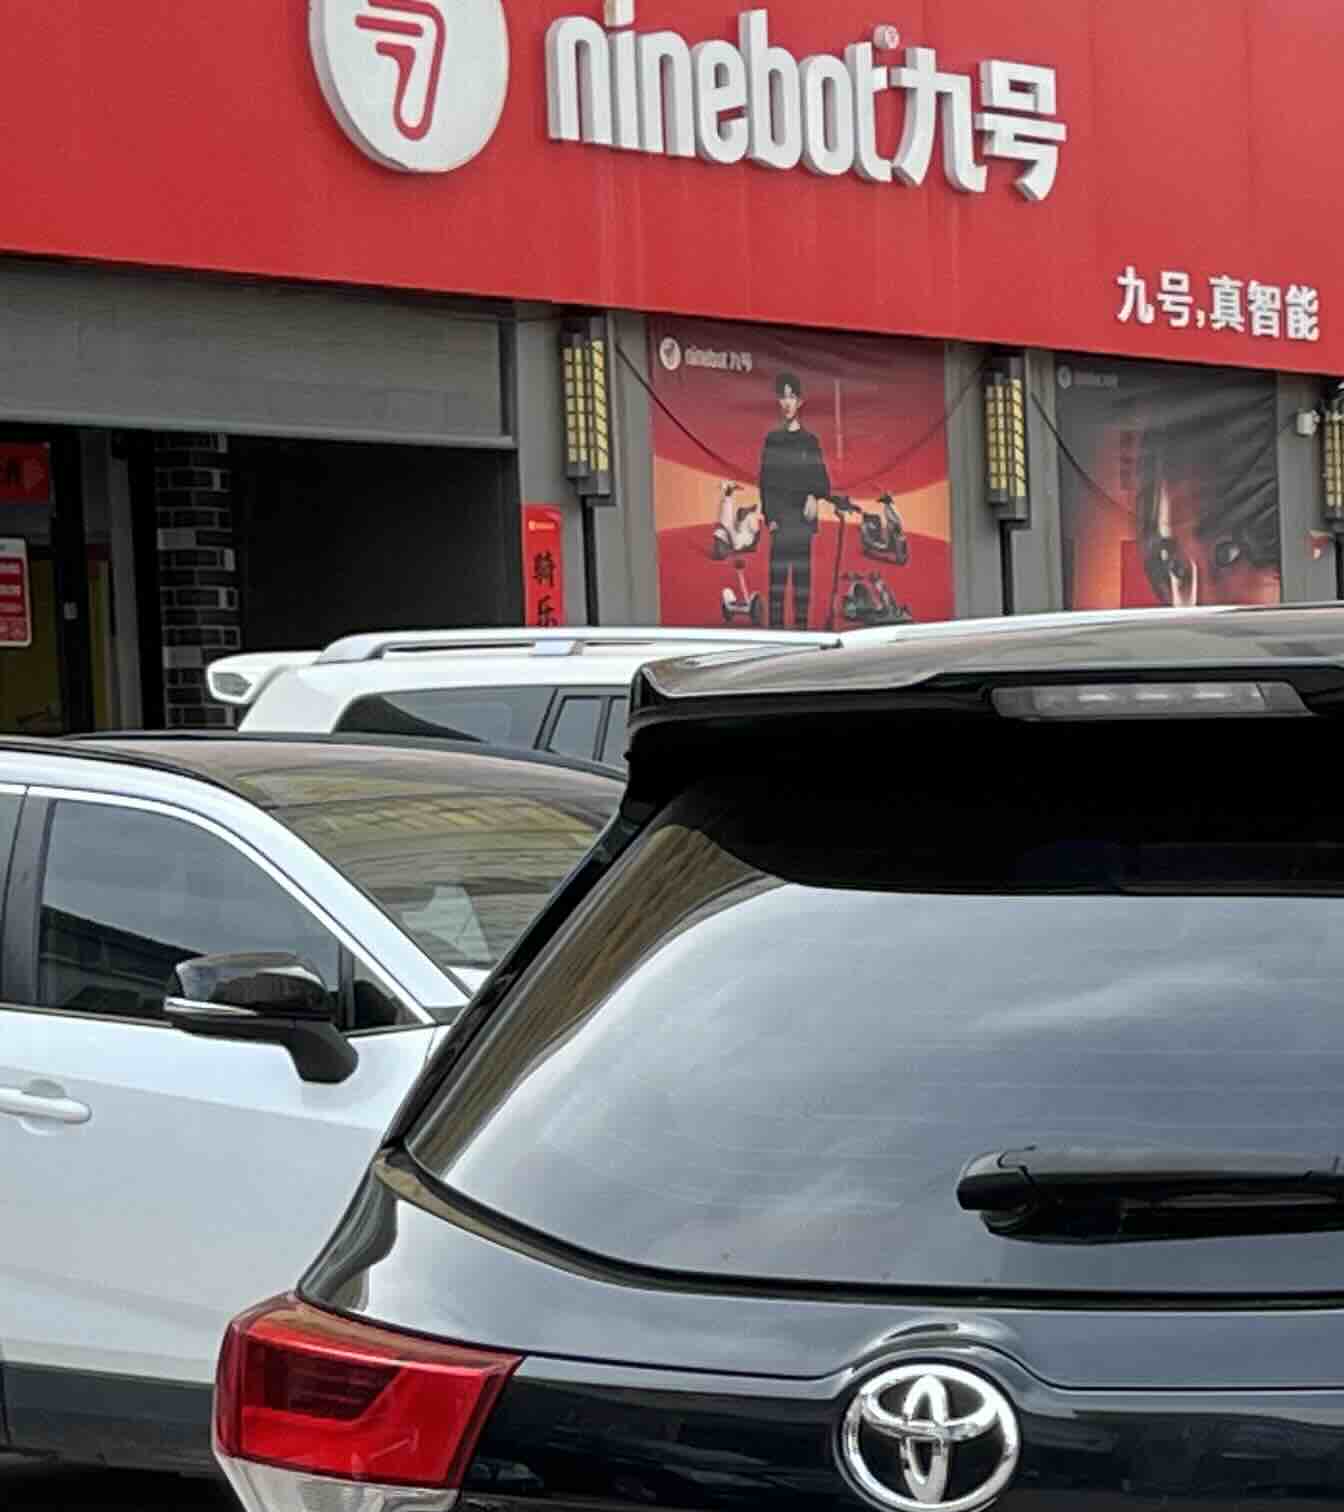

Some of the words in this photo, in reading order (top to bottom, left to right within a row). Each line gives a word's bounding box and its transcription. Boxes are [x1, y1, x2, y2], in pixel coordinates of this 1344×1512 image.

[1116, 265, 1320, 341] 九号，真智能
